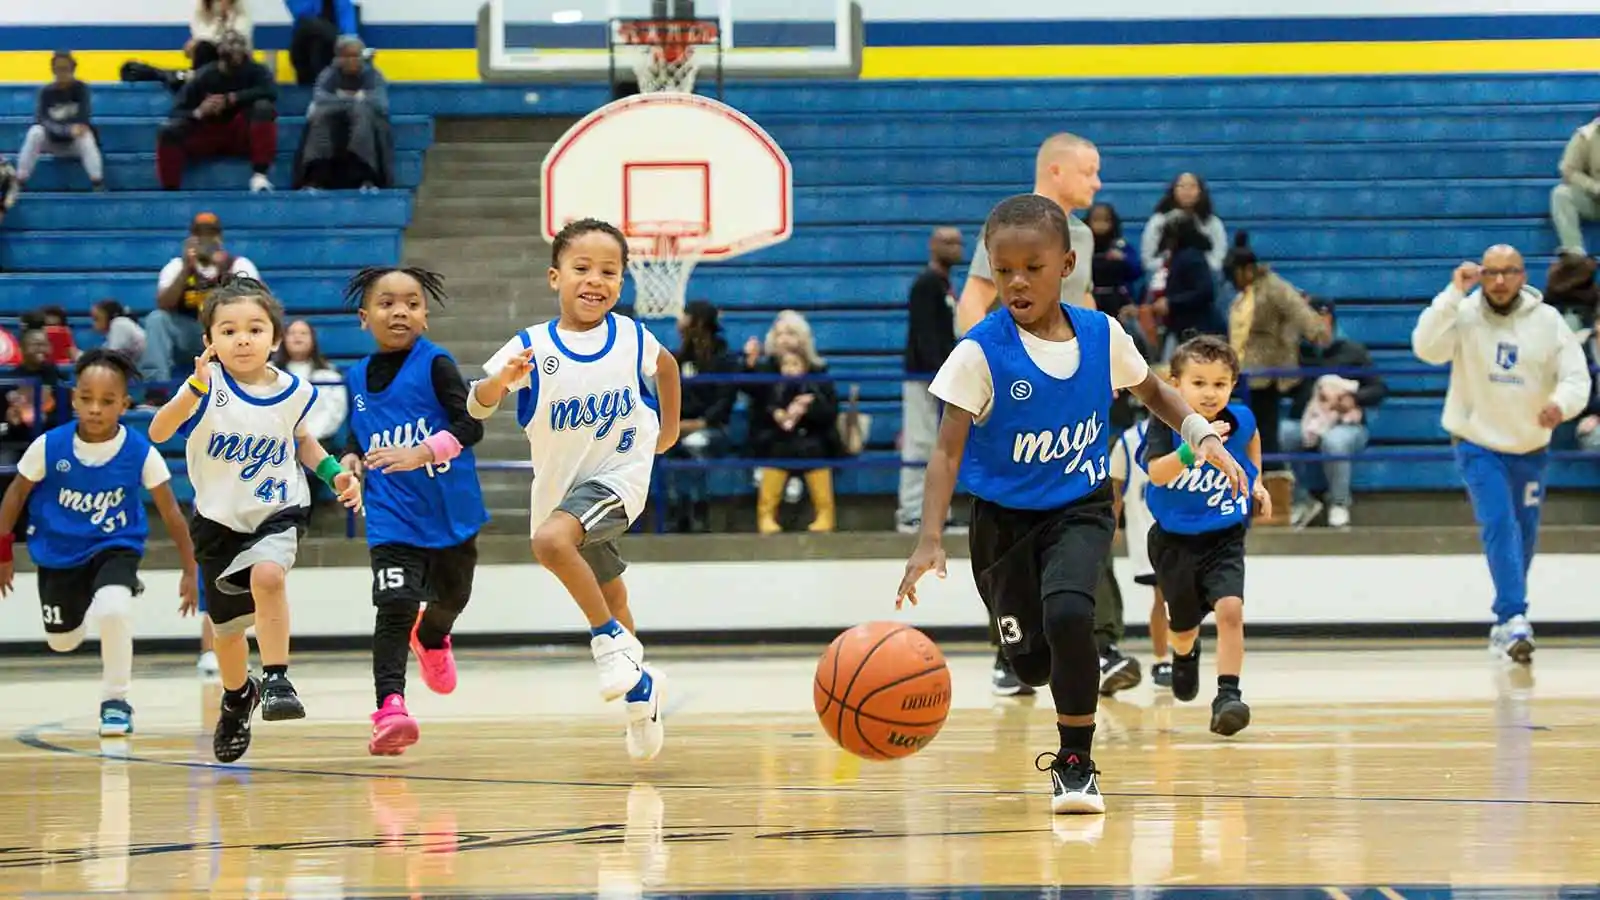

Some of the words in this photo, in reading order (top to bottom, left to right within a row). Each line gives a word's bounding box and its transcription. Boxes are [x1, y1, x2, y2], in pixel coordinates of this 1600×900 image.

[551, 386, 636, 441] msys
[208, 431, 289, 481] msys
[615, 427, 637, 453] 5
[1012, 411, 1104, 473] msys
[254, 476, 289, 503] 41
[58, 487, 126, 525] msys
[376, 568, 404, 590] 15
[43, 605, 63, 624] 31
